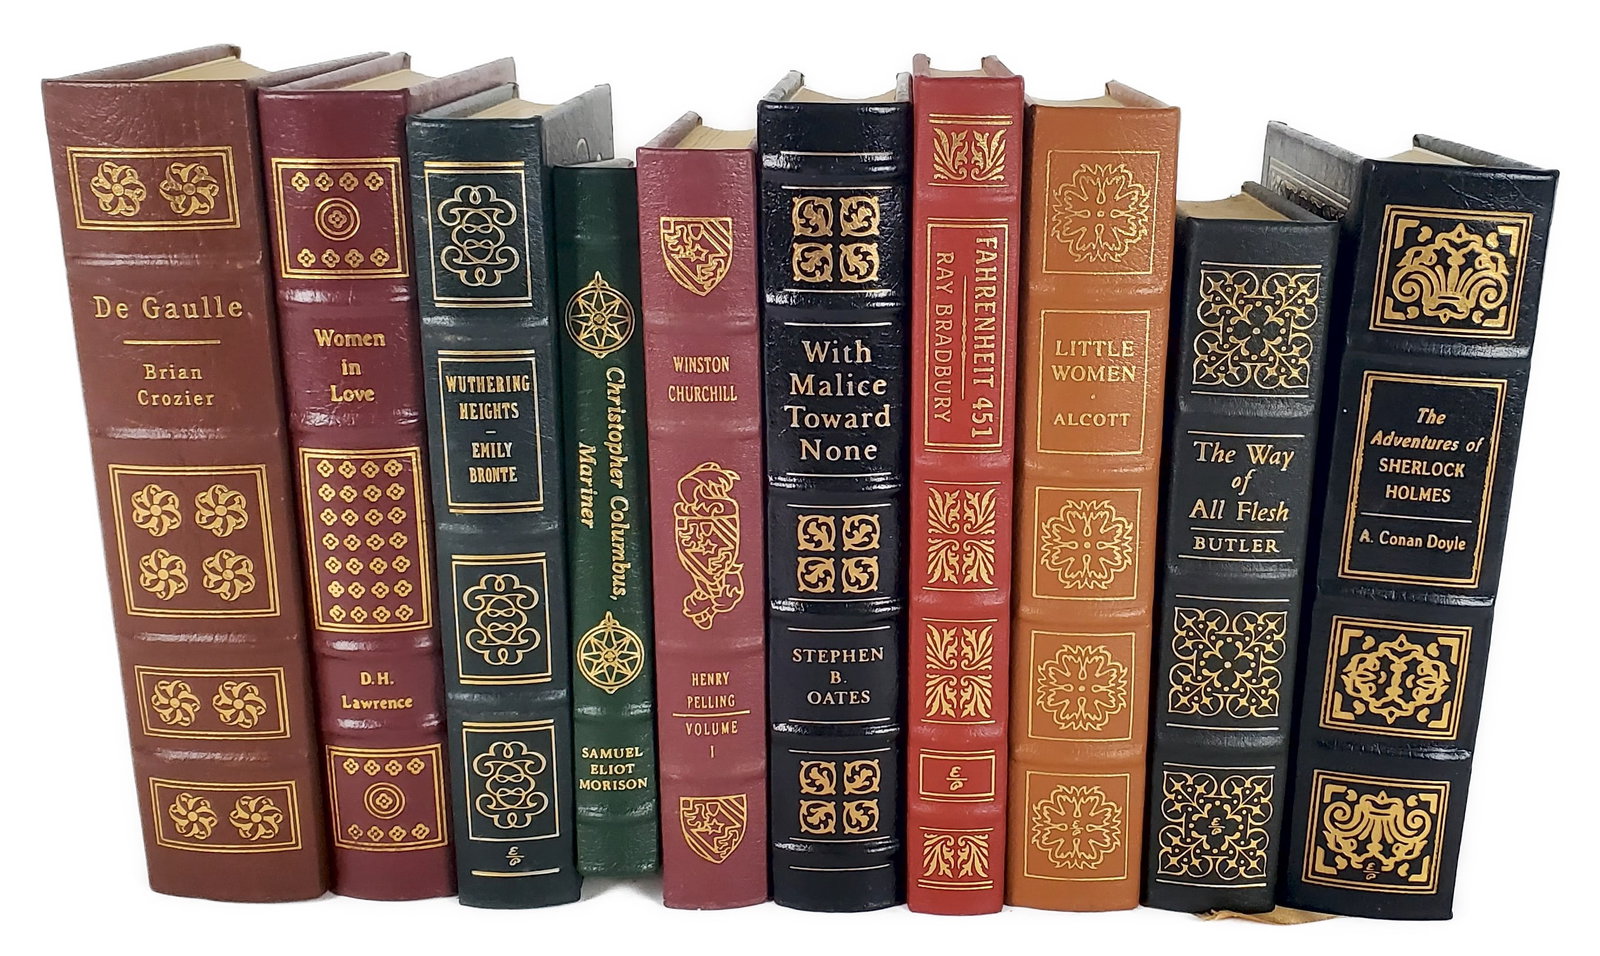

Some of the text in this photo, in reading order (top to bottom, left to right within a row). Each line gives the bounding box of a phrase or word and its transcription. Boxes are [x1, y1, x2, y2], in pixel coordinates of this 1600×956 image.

[93, 296, 243, 318] De Gaulle
[314, 329, 385, 347] Women
[934, 252, 954, 422] RAY BRADBURY
[972, 237, 997, 438] FAHRENHEIT 451
[802, 340, 871, 363] With
[1055, 340, 1134, 358] LITTLE
[143, 364, 202, 379] Brian
[342, 359, 361, 375] in
[673, 357, 729, 373] WINSTON
[1052, 365, 1136, 381] WOMEN
[446, 375, 530, 392] WUTHERING
[790, 373, 886, 396] Malice
[137, 390, 214, 406] Crozier
[331, 385, 374, 402] Love
[669, 386, 737, 402] CHURCHILL
[460, 403, 519, 419] HEIGHTS
[784, 404, 890, 428] Toward
[1417, 408, 1446, 424] The
[1054, 413, 1130, 426] ALCOTT
[800, 439, 877, 460] None
[1371, 431, 1484, 452] Adventures of
[472, 443, 512, 458] EMILY
[1194, 441, 1294, 471] The Way
[469, 467, 517, 482] BRONTE
[1379, 458, 1465, 477] SHERLOCK
[579, 442, 597, 529] Mariner
[604, 367, 631, 600] Christopher Columbus,
[1232, 469, 1256, 495] of
[1386, 485, 1450, 502] HOLMES
[1189, 499, 1289, 521] All Flesh
[1193, 537, 1280, 552] BUTLER
[1359, 529, 1465, 552] A. Conan Doyle
[793, 647, 883, 662] STEPHEN
[361, 672, 394, 685] D.H.
[692, 672, 729, 686] HENRY
[831, 671, 846, 683] B.
[342, 695, 412, 709] Lawrence
[688, 695, 734, 708] PELLING
[807, 690, 870, 704] OATES
[686, 721, 737, 736] VOLUME
[582, 747, 643, 759] SAMUEL
[711, 746, 714, 758] I
[591, 764, 635, 775] ELIOT
[580, 778, 647, 790] MORISON
